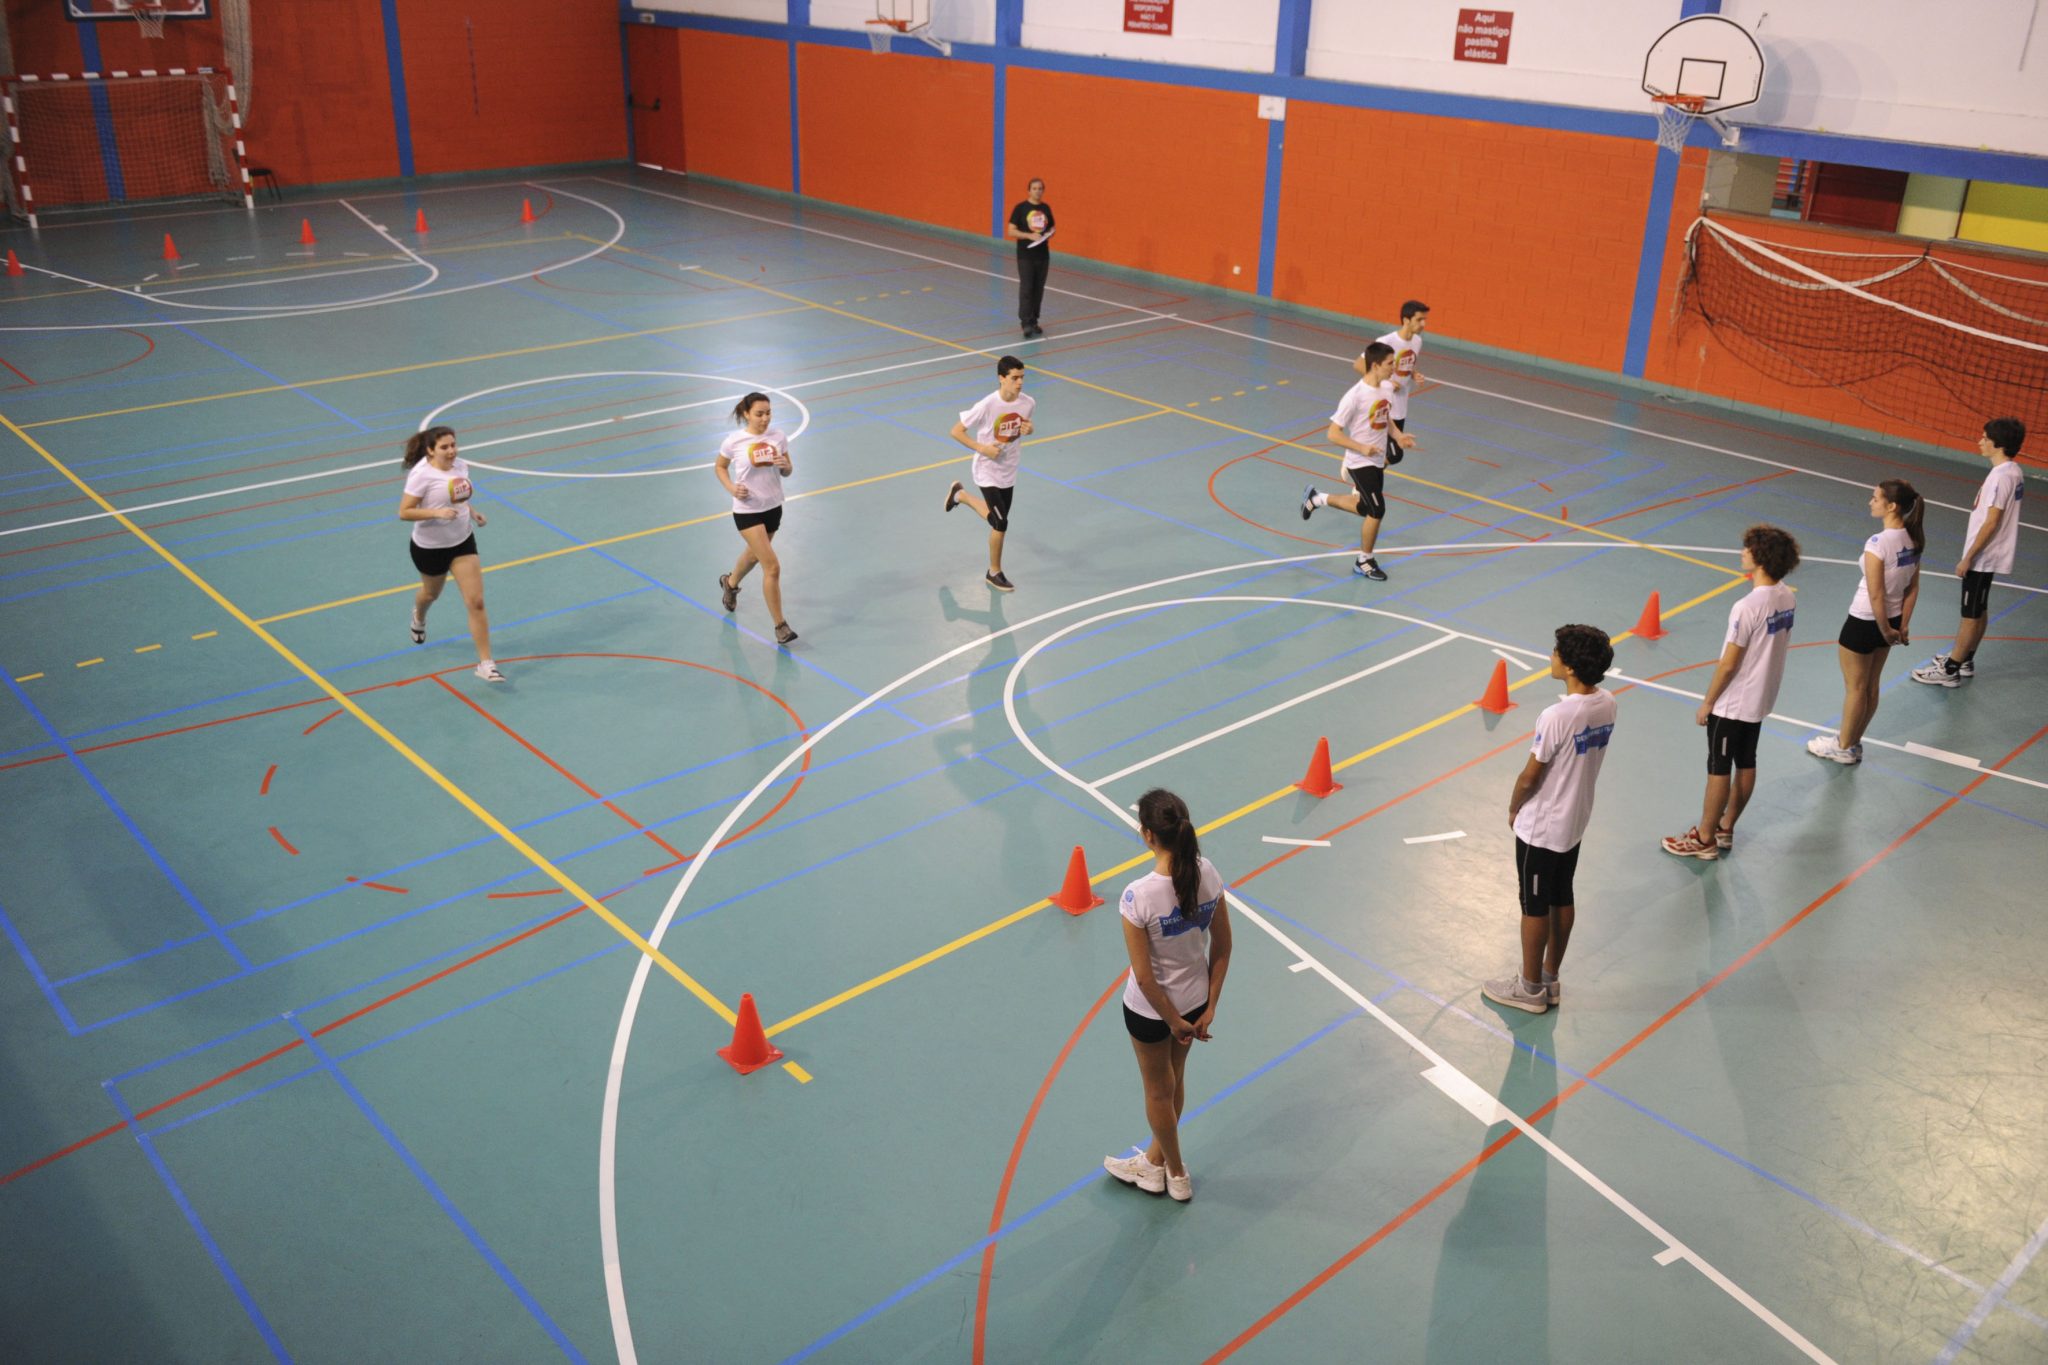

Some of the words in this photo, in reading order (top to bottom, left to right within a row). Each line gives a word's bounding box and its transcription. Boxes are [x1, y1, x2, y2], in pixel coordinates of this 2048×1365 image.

[1474, 12, 1496, 24] Aqui
[1457, 24, 1474, 34] não
[1474, 26, 1510, 38] mastigo
[1465, 37, 1499, 48] pastilha
[1464, 48, 1497, 60] elástica
